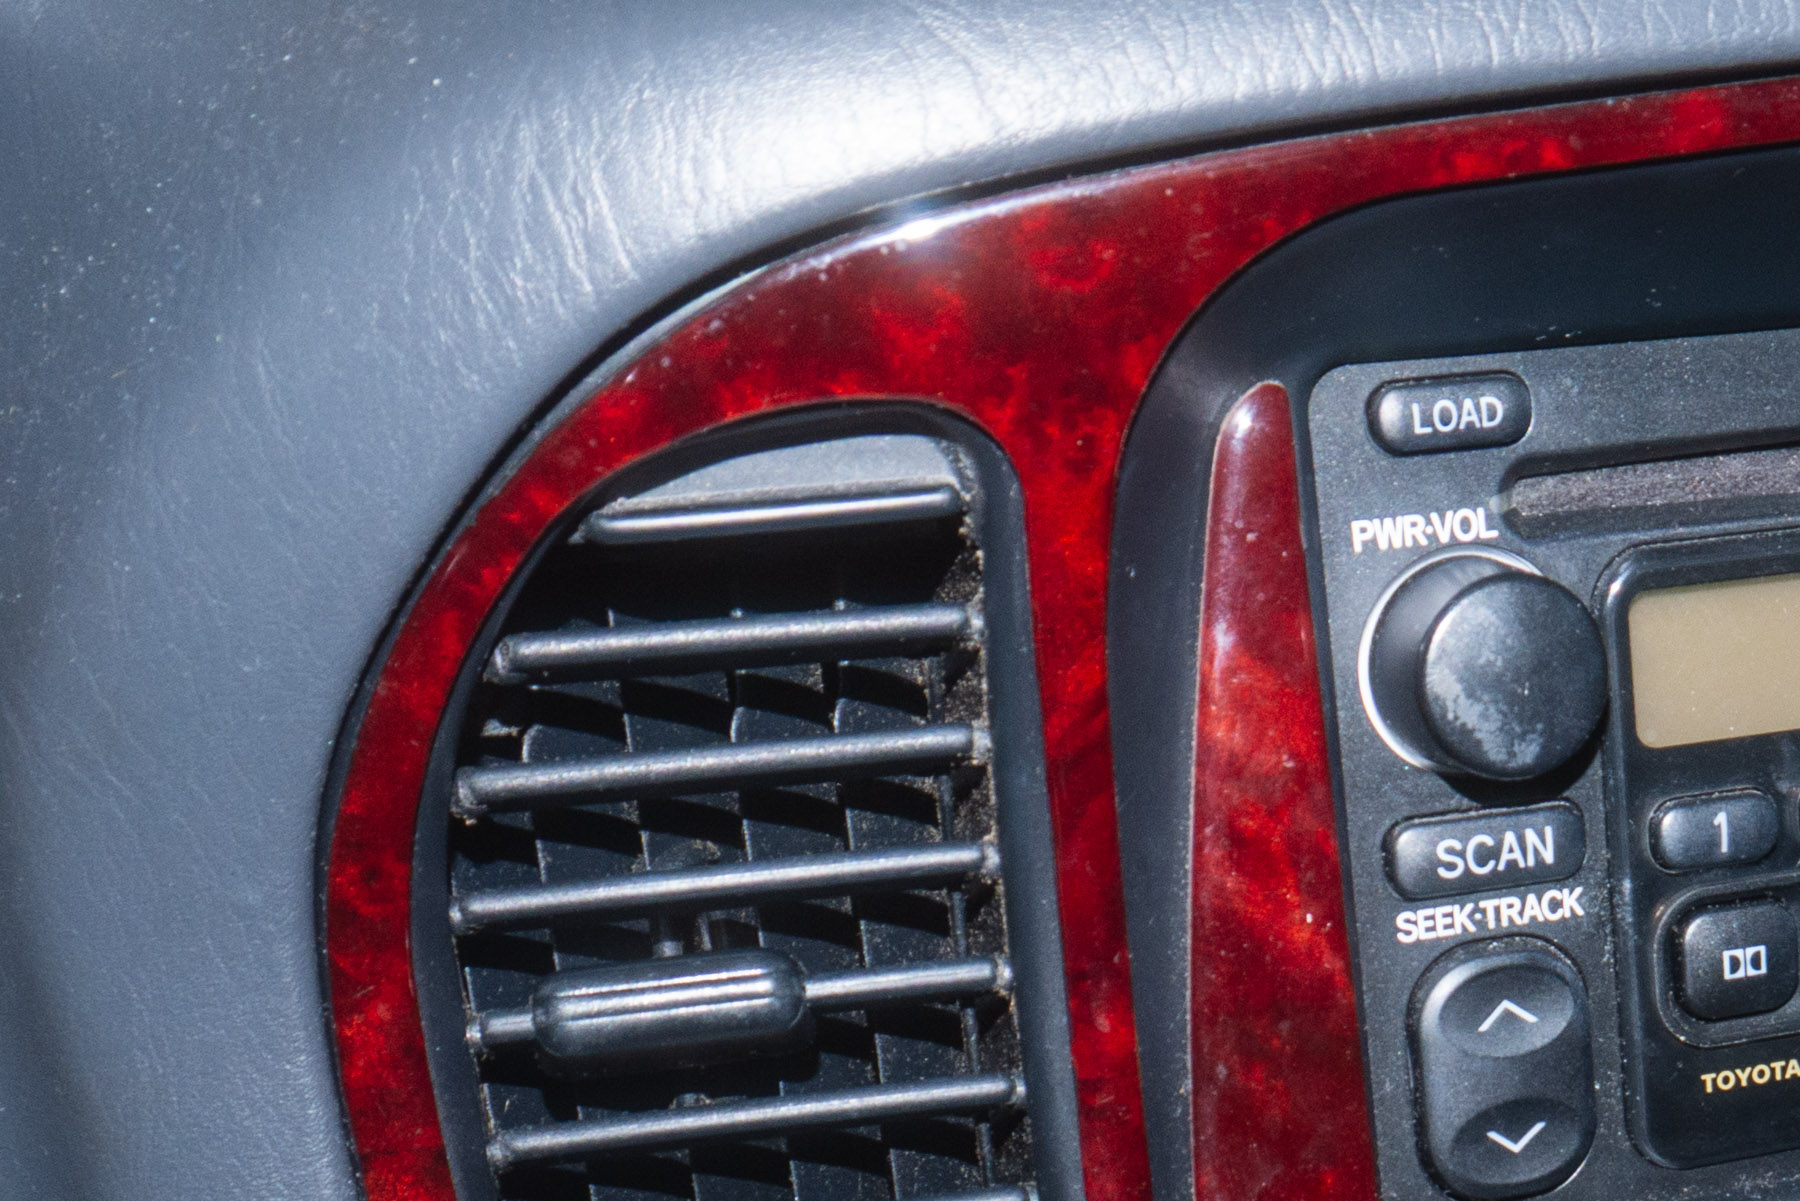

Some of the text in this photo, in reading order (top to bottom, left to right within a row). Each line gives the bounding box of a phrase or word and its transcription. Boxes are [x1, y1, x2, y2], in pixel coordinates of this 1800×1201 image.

[1411, 396, 1504, 434] LOAD
[1436, 825, 1555, 880] SCAN
[1713, 812, 1730, 854] 1
